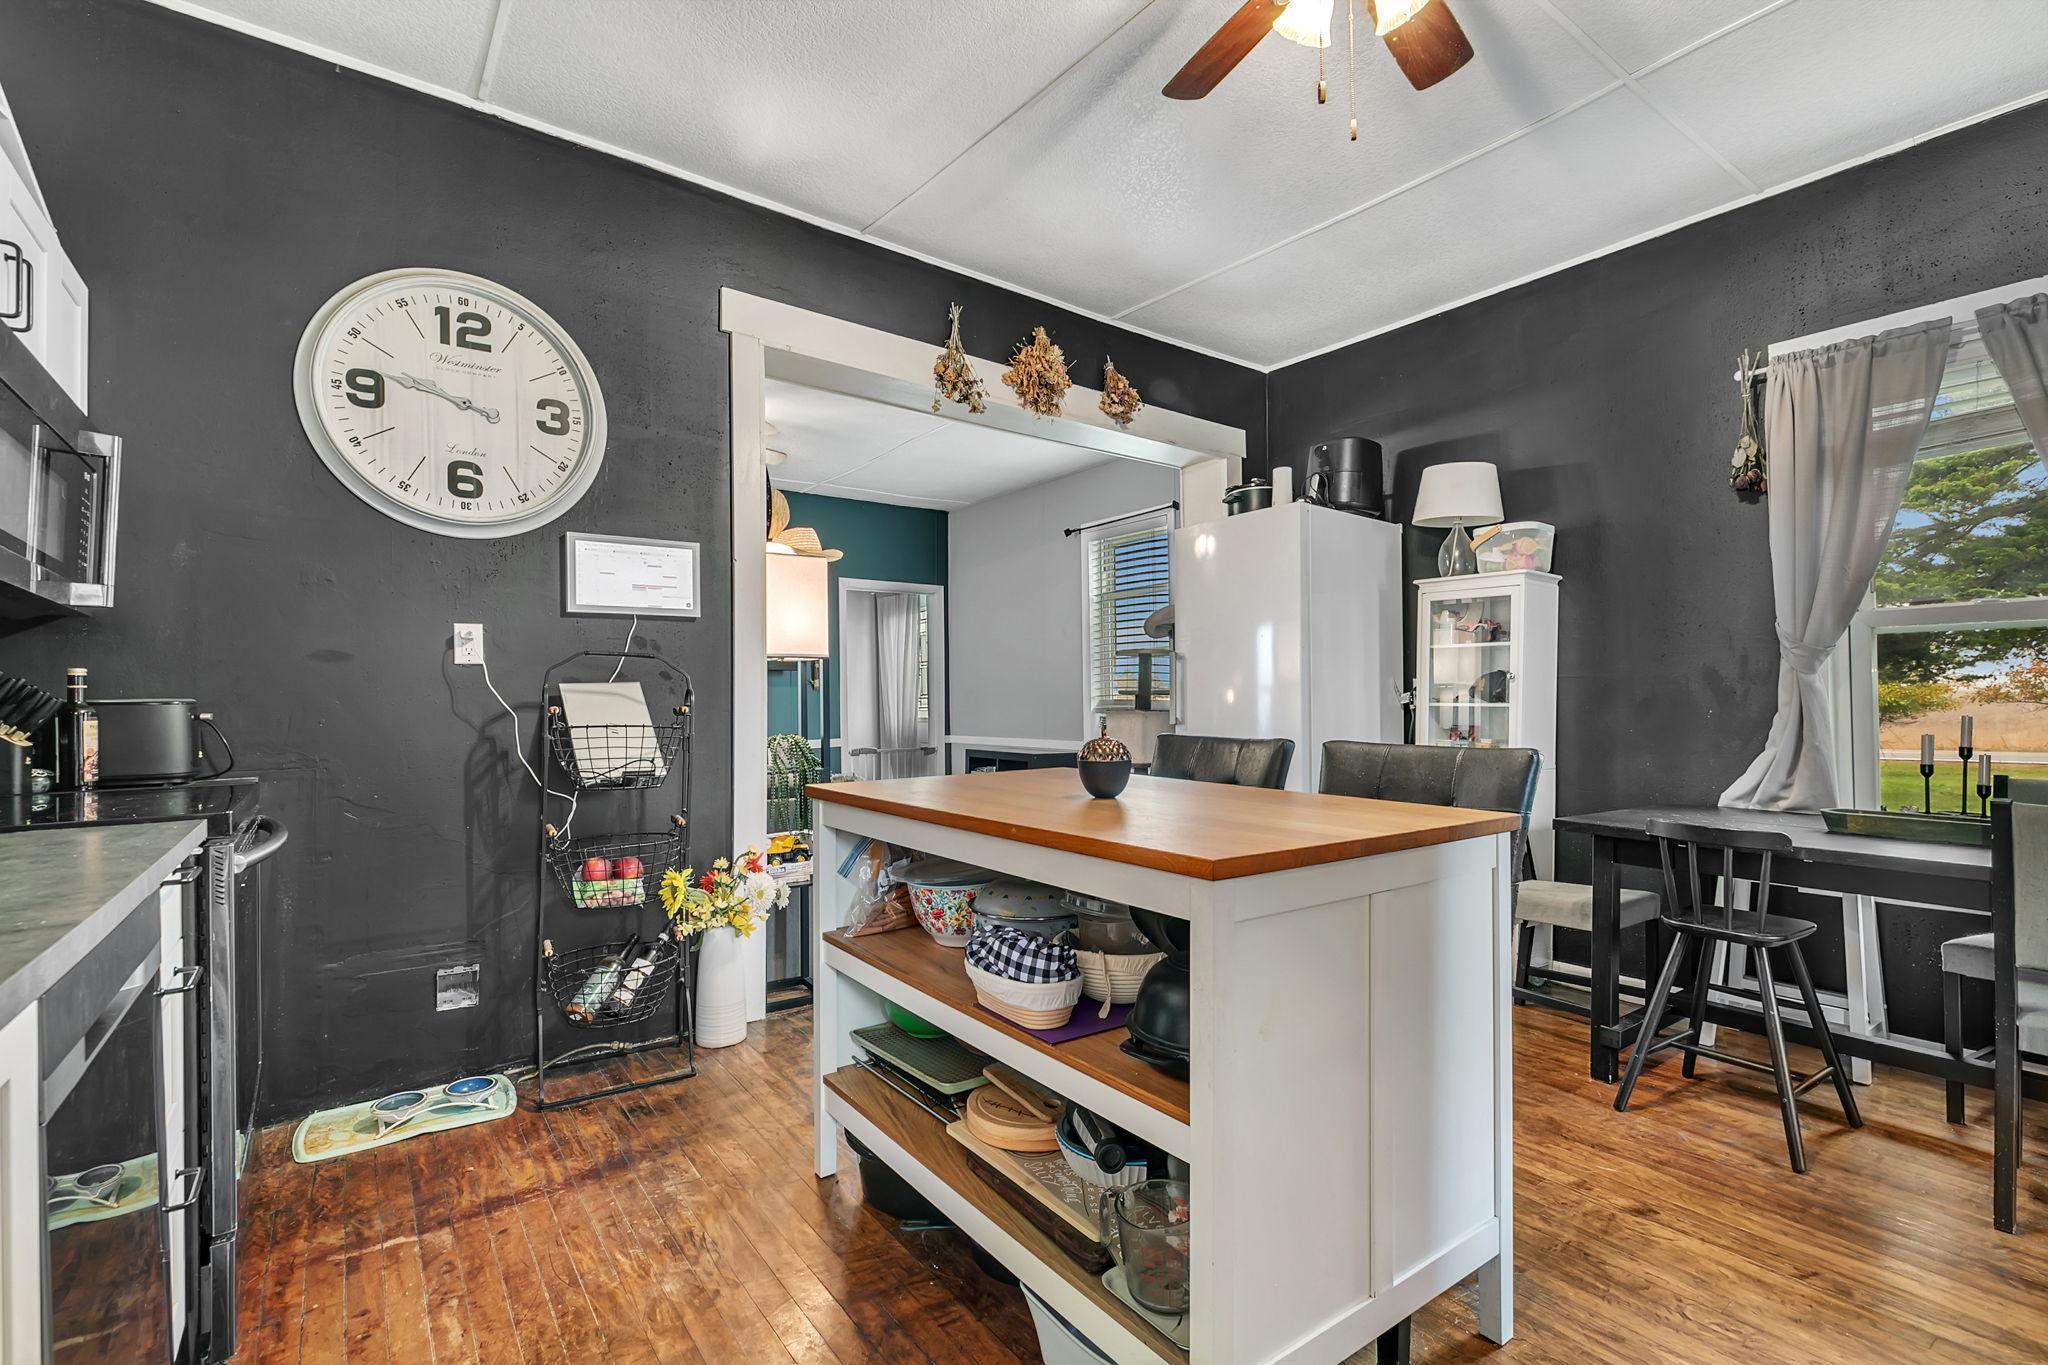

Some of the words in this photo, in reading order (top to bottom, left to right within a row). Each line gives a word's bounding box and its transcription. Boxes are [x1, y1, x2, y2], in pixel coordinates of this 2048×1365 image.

[395, 298, 408, 308] 55
[457, 296, 469, 307] 60
[347, 327, 361, 339] 50
[434, 305, 492, 353] 12
[517, 323, 526, 331] 5
[429, 352, 504, 374] Westminster
[556, 365, 567, 376] 10
[331, 378, 342, 390] 45
[345, 368, 385, 408] 9
[536, 398, 571, 436] 3
[572, 416, 582, 426] 15
[348, 436, 362, 448] 40
[445, 441, 487, 458] London
[557, 461, 569, 473] 20
[447, 460, 484, 499] 6
[397, 480, 412, 492] 35
[517, 493, 530, 504] 25
[460, 501, 472, 511] 30
[1023, 1161, 1061, 1187] SALTY
